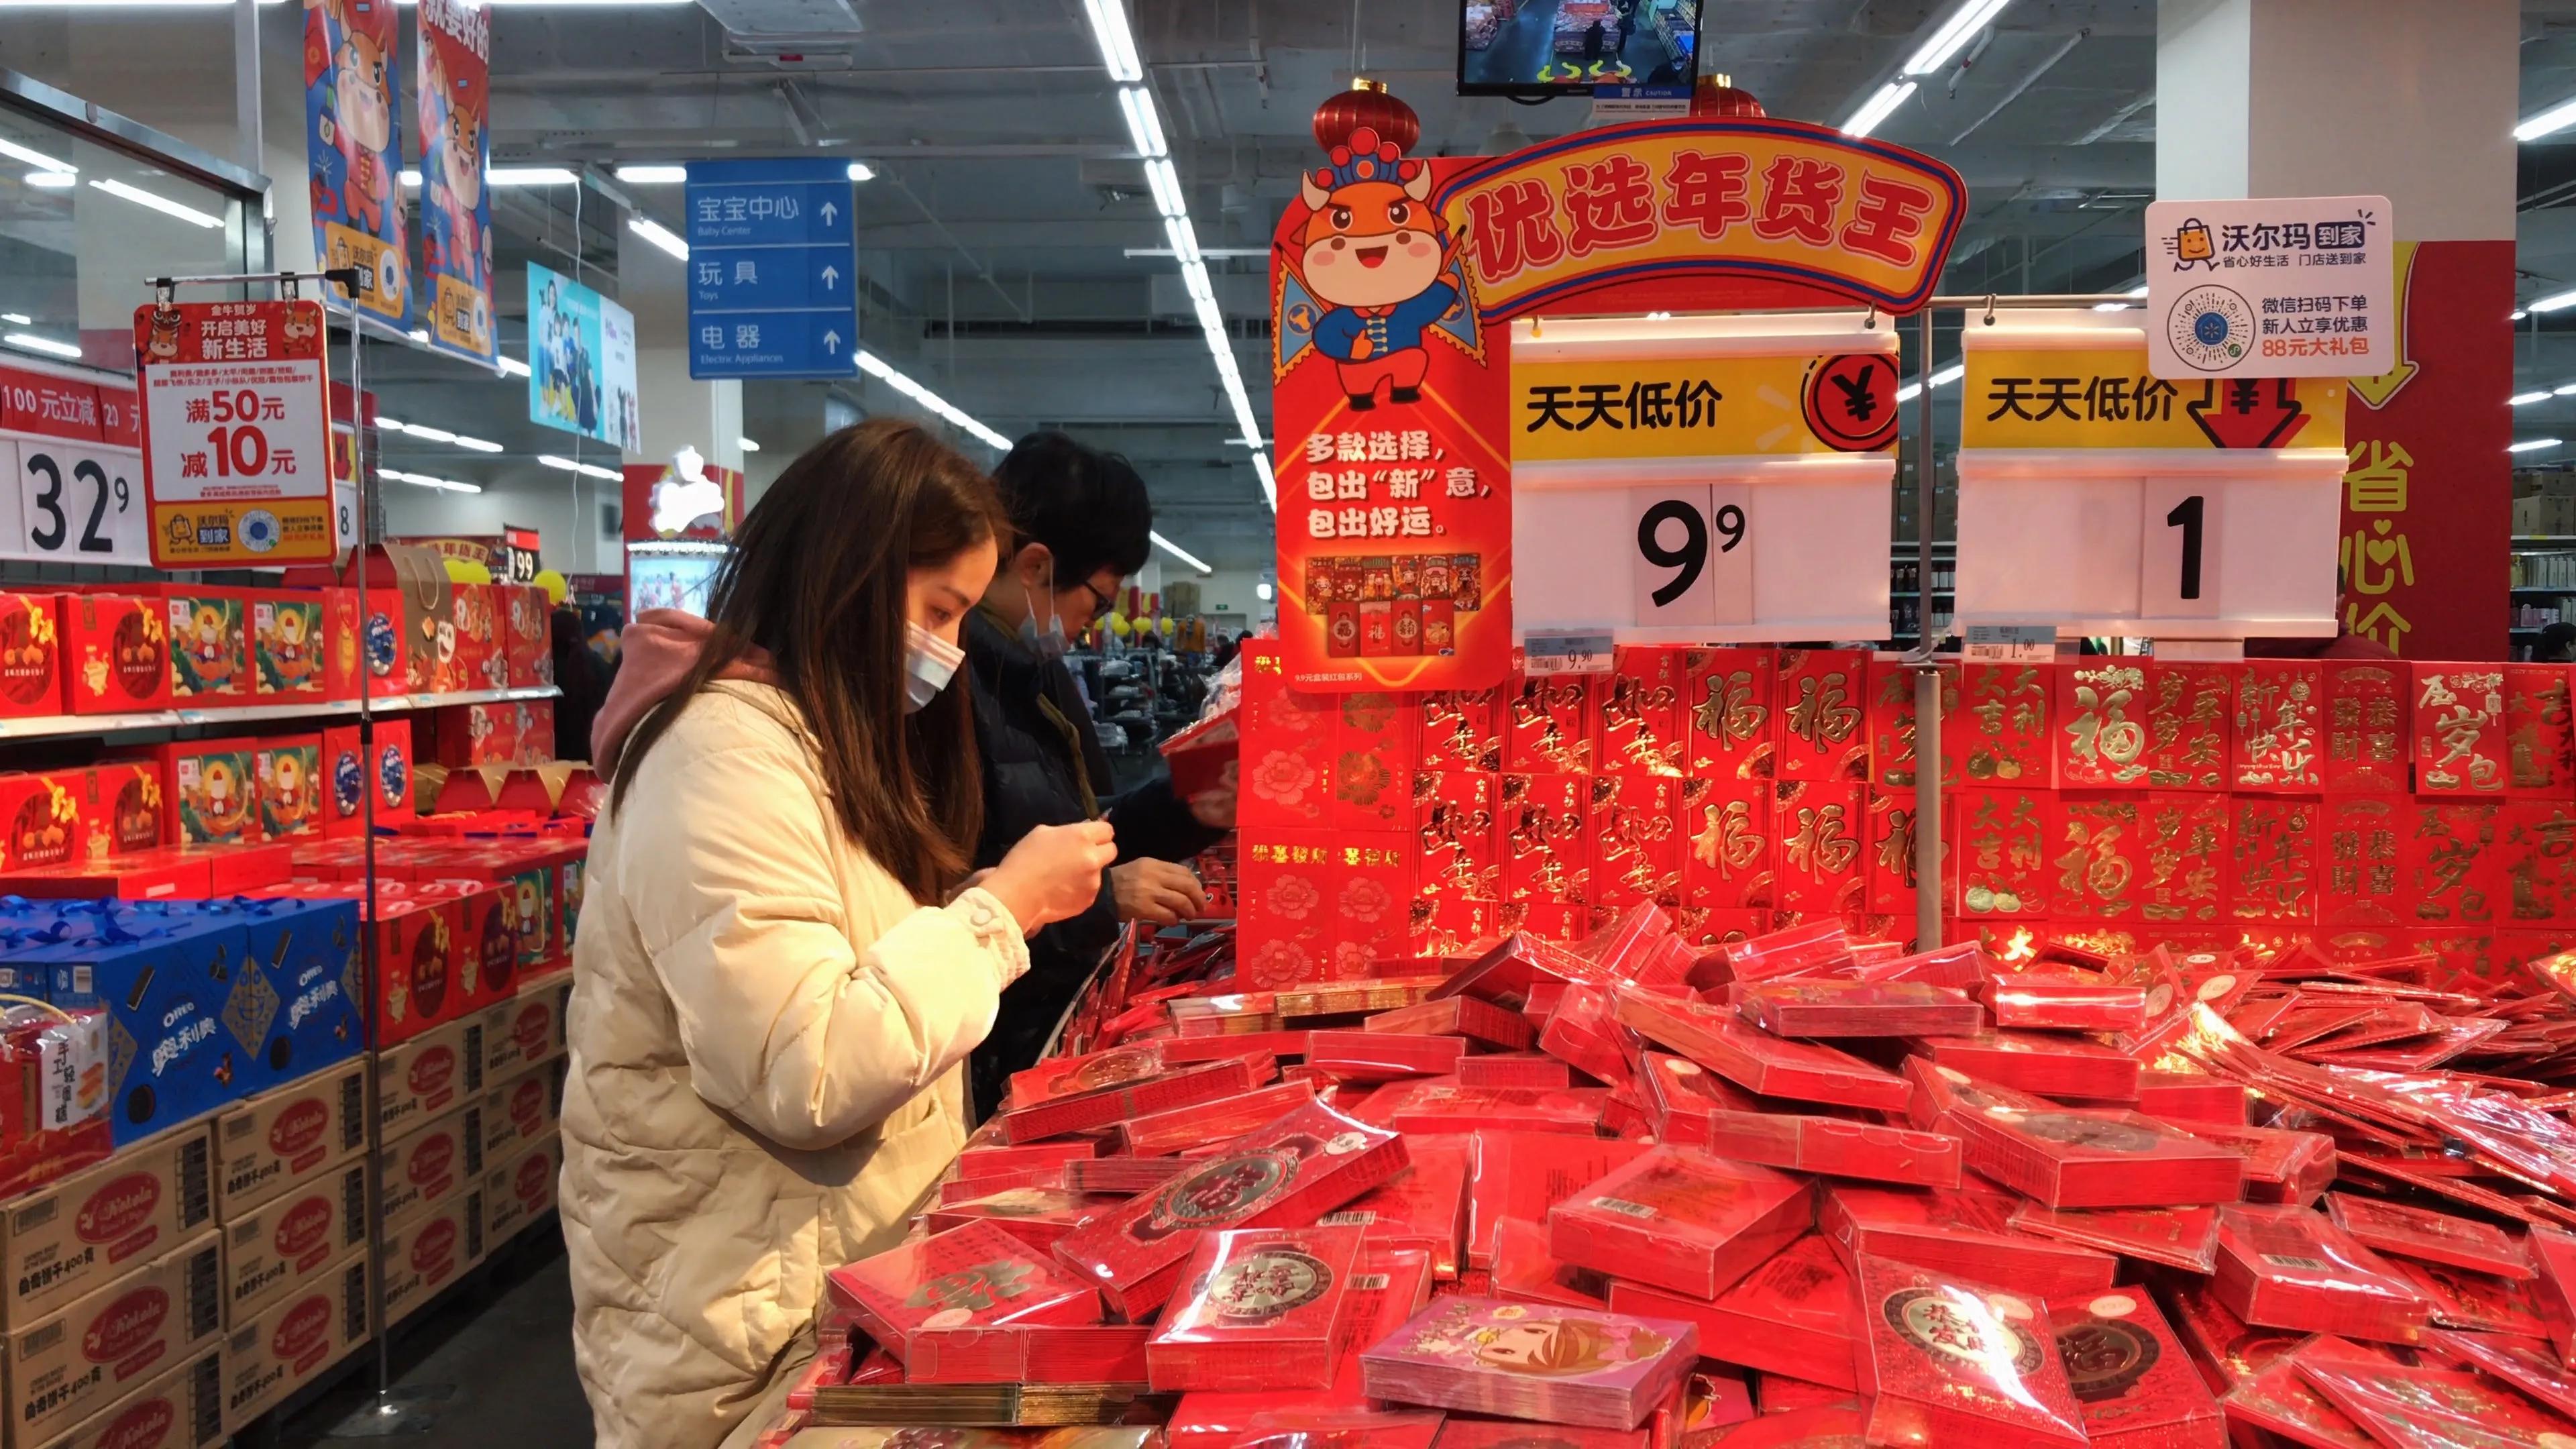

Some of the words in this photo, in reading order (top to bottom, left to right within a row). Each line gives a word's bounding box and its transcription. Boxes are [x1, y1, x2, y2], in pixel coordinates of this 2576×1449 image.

[698, 196, 800, 223] 宝宝中心
[1466, 149, 1935, 282] 优选年货王
[698, 227, 719, 236] Baby
[721, 226, 751, 235] Center
[2221, 223, 2310, 252] 沃尔玛
[2318, 225, 2362, 247] 到家
[698, 261, 758, 285] 玩具
[2223, 254, 2290, 268] 省心好生活
[2298, 252, 2367, 266] 门店送到家
[698, 290, 718, 301] Toys
[2261, 294, 2367, 314] 微信扫码下单
[211, 304, 257, 317] 金牛贺岁
[201, 319, 266, 336] 开启美好
[702, 325, 761, 350] 电器
[2262, 315, 2368, 335] 新人立享优惠
[201, 337, 268, 360] 新生活
[700, 354, 734, 365] Electric
[735, 353, 784, 364] Appliances
[2261, 337, 2369, 358] 88元大礼包
[185, 389, 286, 424] 满50元
[1525, 379, 1723, 433] 天天低价
[1986, 376, 2179, 421] 天天低价
[1305, 429, 1444, 463] 多款选择，
[341, 506, 350, 535] 8
[1306, 506, 1446, 539] 包出好运。
[199, 527, 229, 544] 到家
[2166, 494, 2204, 600] 1
[1567, 649, 1593, 669] 9.90
[2010, 638, 2035, 659] 1.00
[1690, 670, 1769, 753] 福
[1784, 672, 1862, 755] 福
[2064, 686, 2147, 764] 福
[1690, 801, 1766, 881] 福
[1782, 804, 1860, 885] 福
